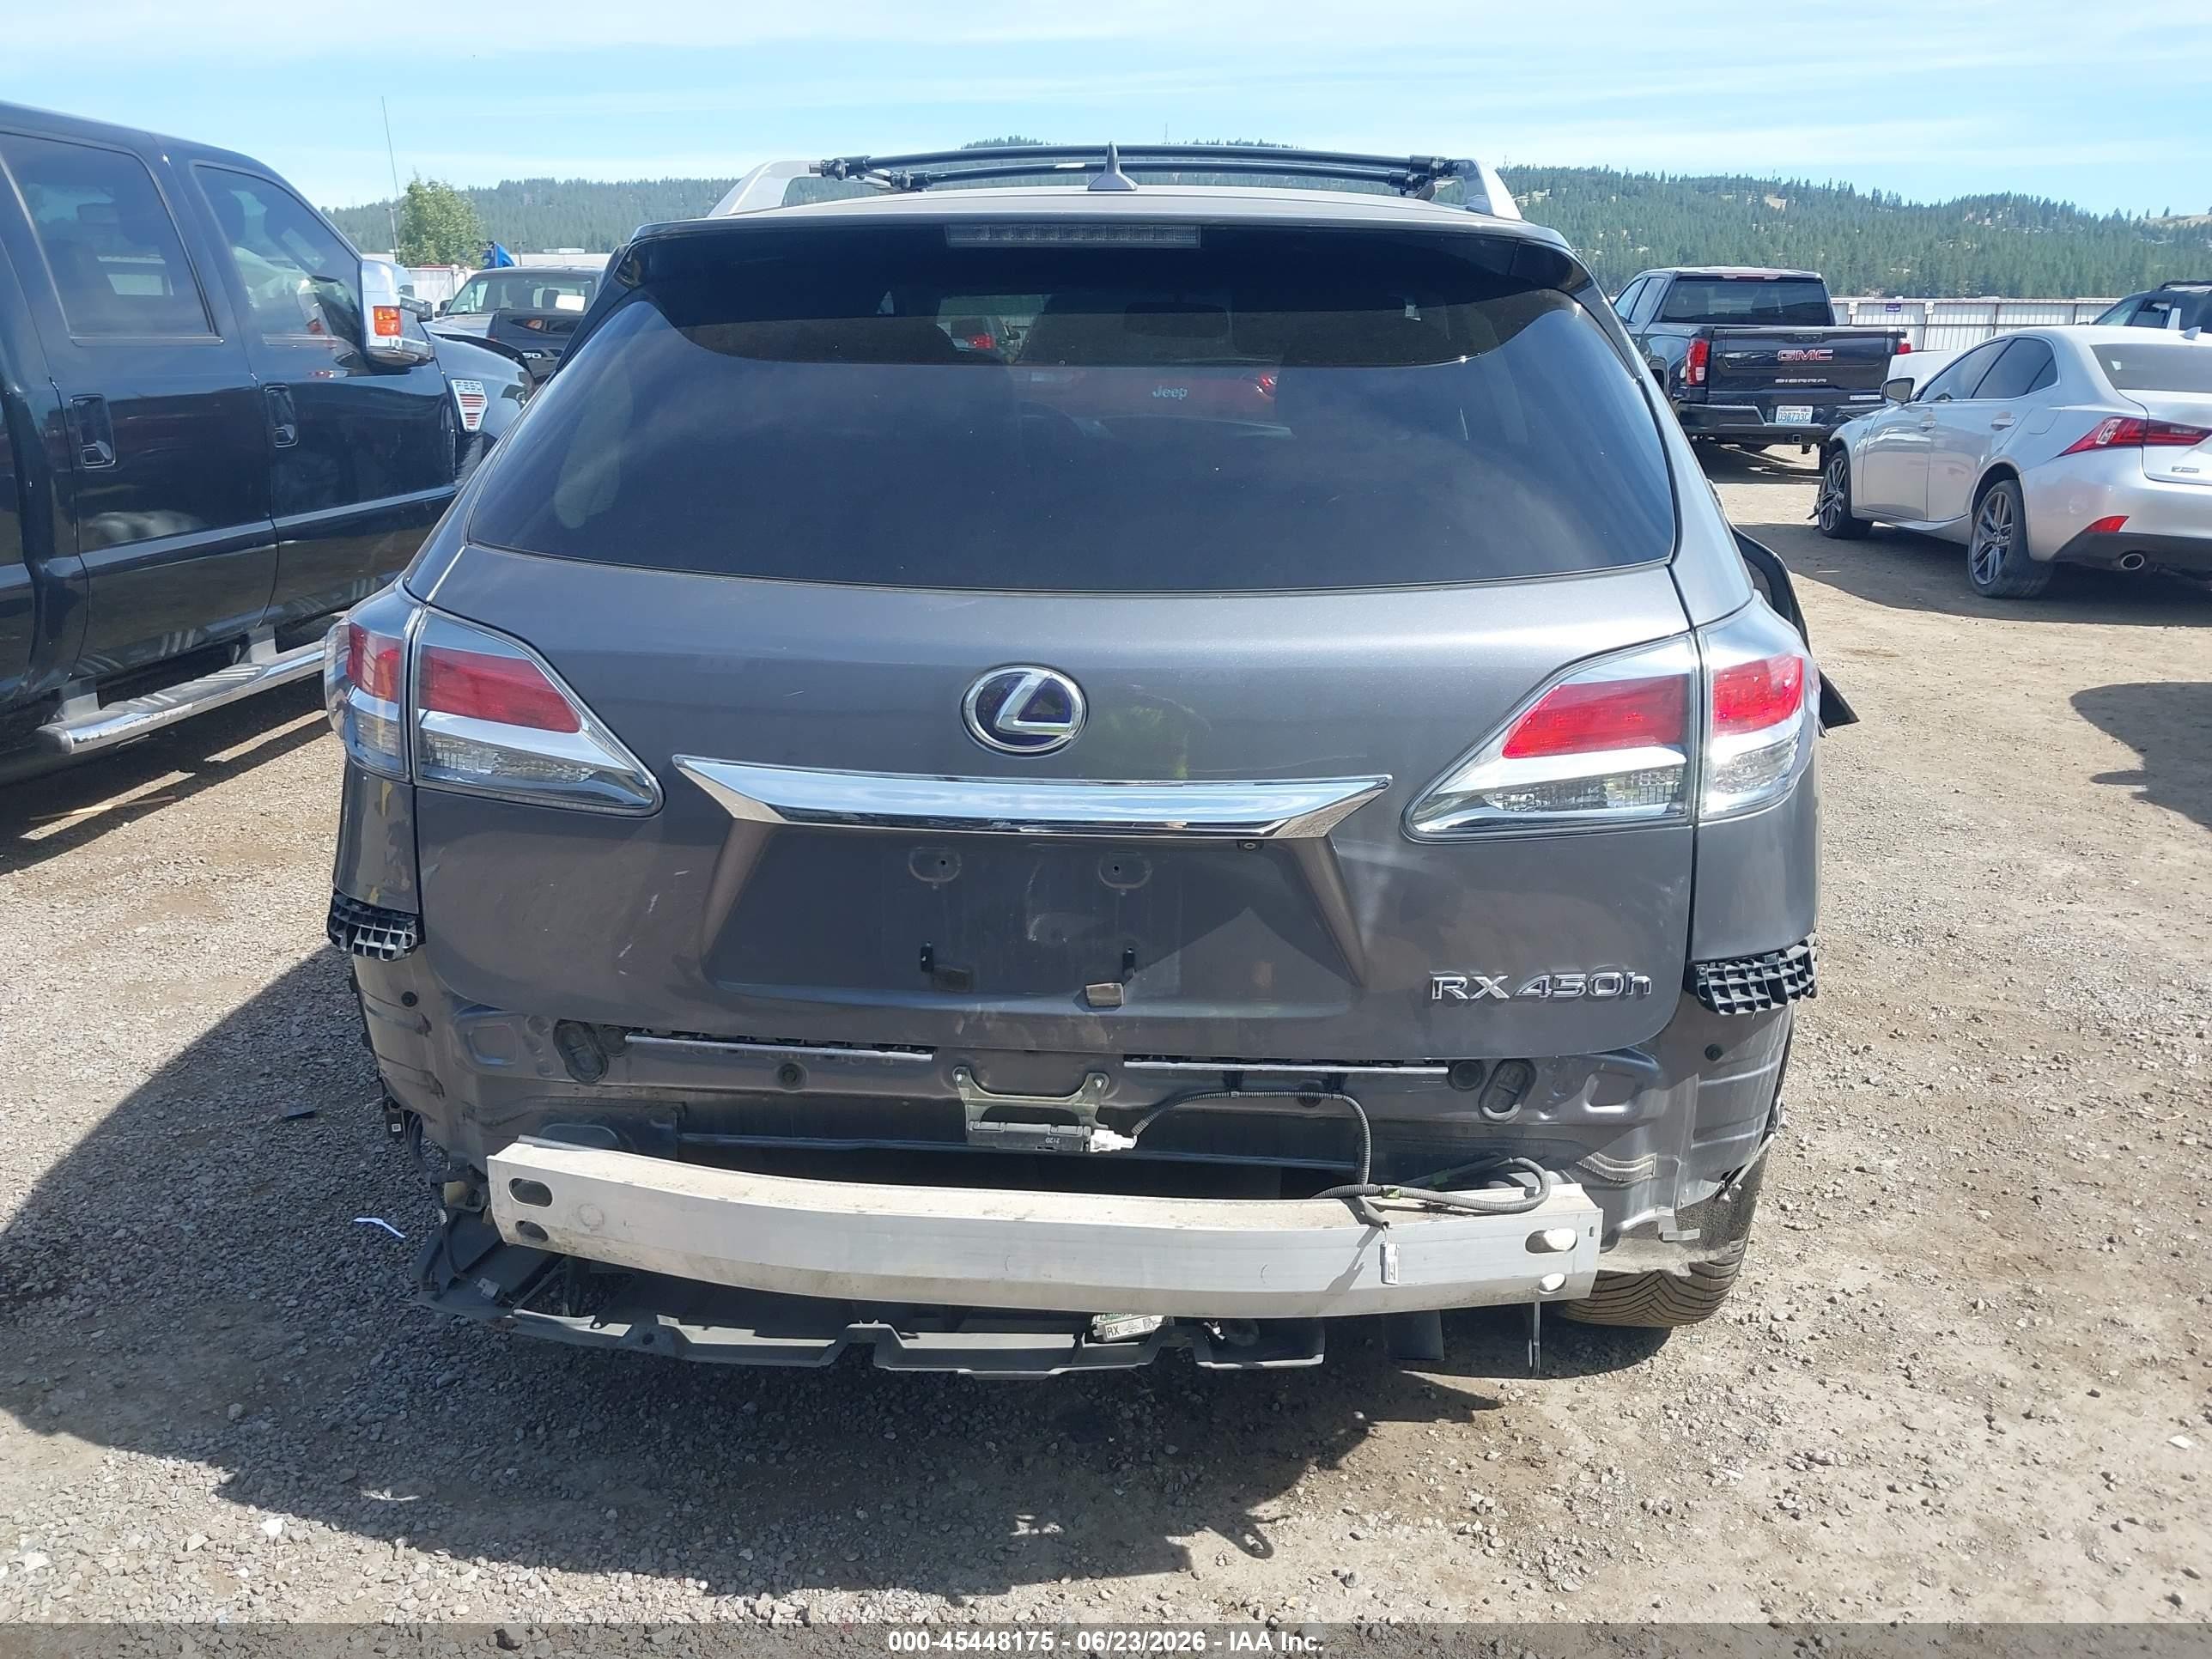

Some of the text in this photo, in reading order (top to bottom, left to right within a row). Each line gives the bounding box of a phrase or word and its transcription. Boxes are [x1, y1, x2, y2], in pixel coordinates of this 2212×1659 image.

[1778, 349, 1833, 362] GMC
[1152, 386, 1188, 400] Jeep
[1778, 411, 1809, 422] D98733C
[1431, 971, 1653, 1000] RX 450h
[1106, 1325, 1121, 1338] RX
